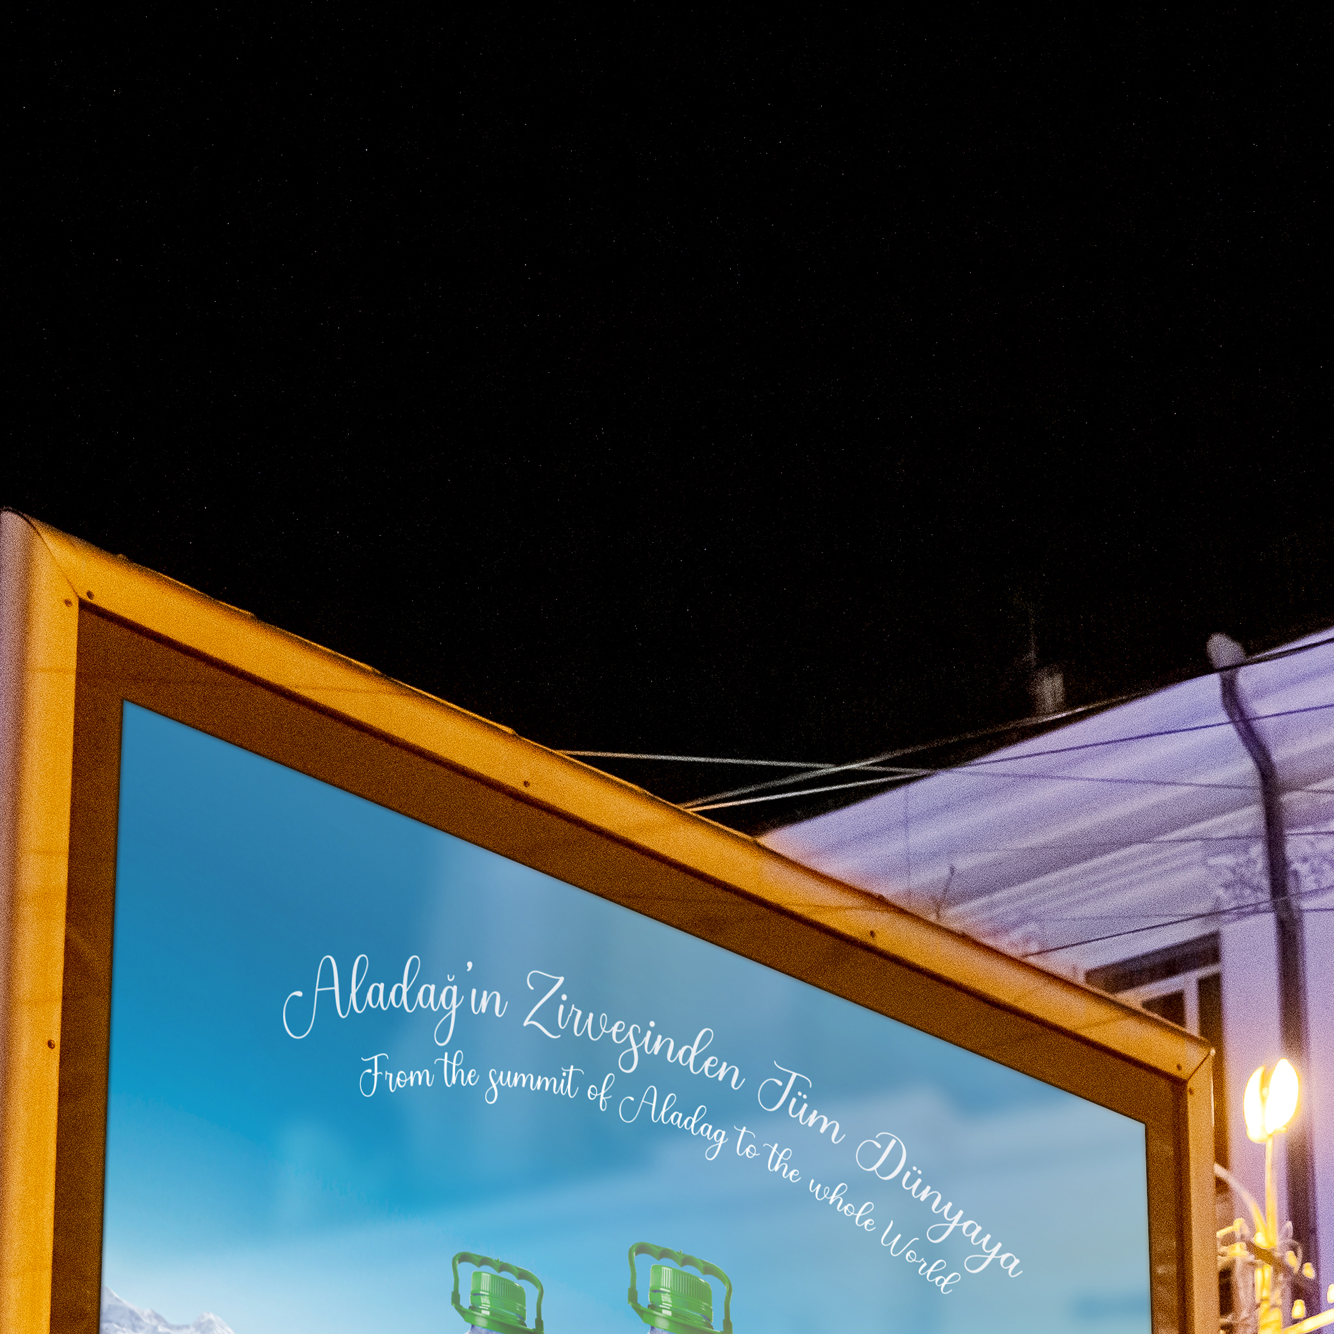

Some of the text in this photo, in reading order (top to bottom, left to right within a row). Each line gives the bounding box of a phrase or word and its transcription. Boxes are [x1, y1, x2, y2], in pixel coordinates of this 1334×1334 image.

[359, 1049, 963, 1296] From the summit of Aladag to the whole World
[523, 969, 747, 1092] Zirvesinden
[757, 1060, 847, 1146] Tüm
[855, 1131, 1024, 1279] Dünyaya
